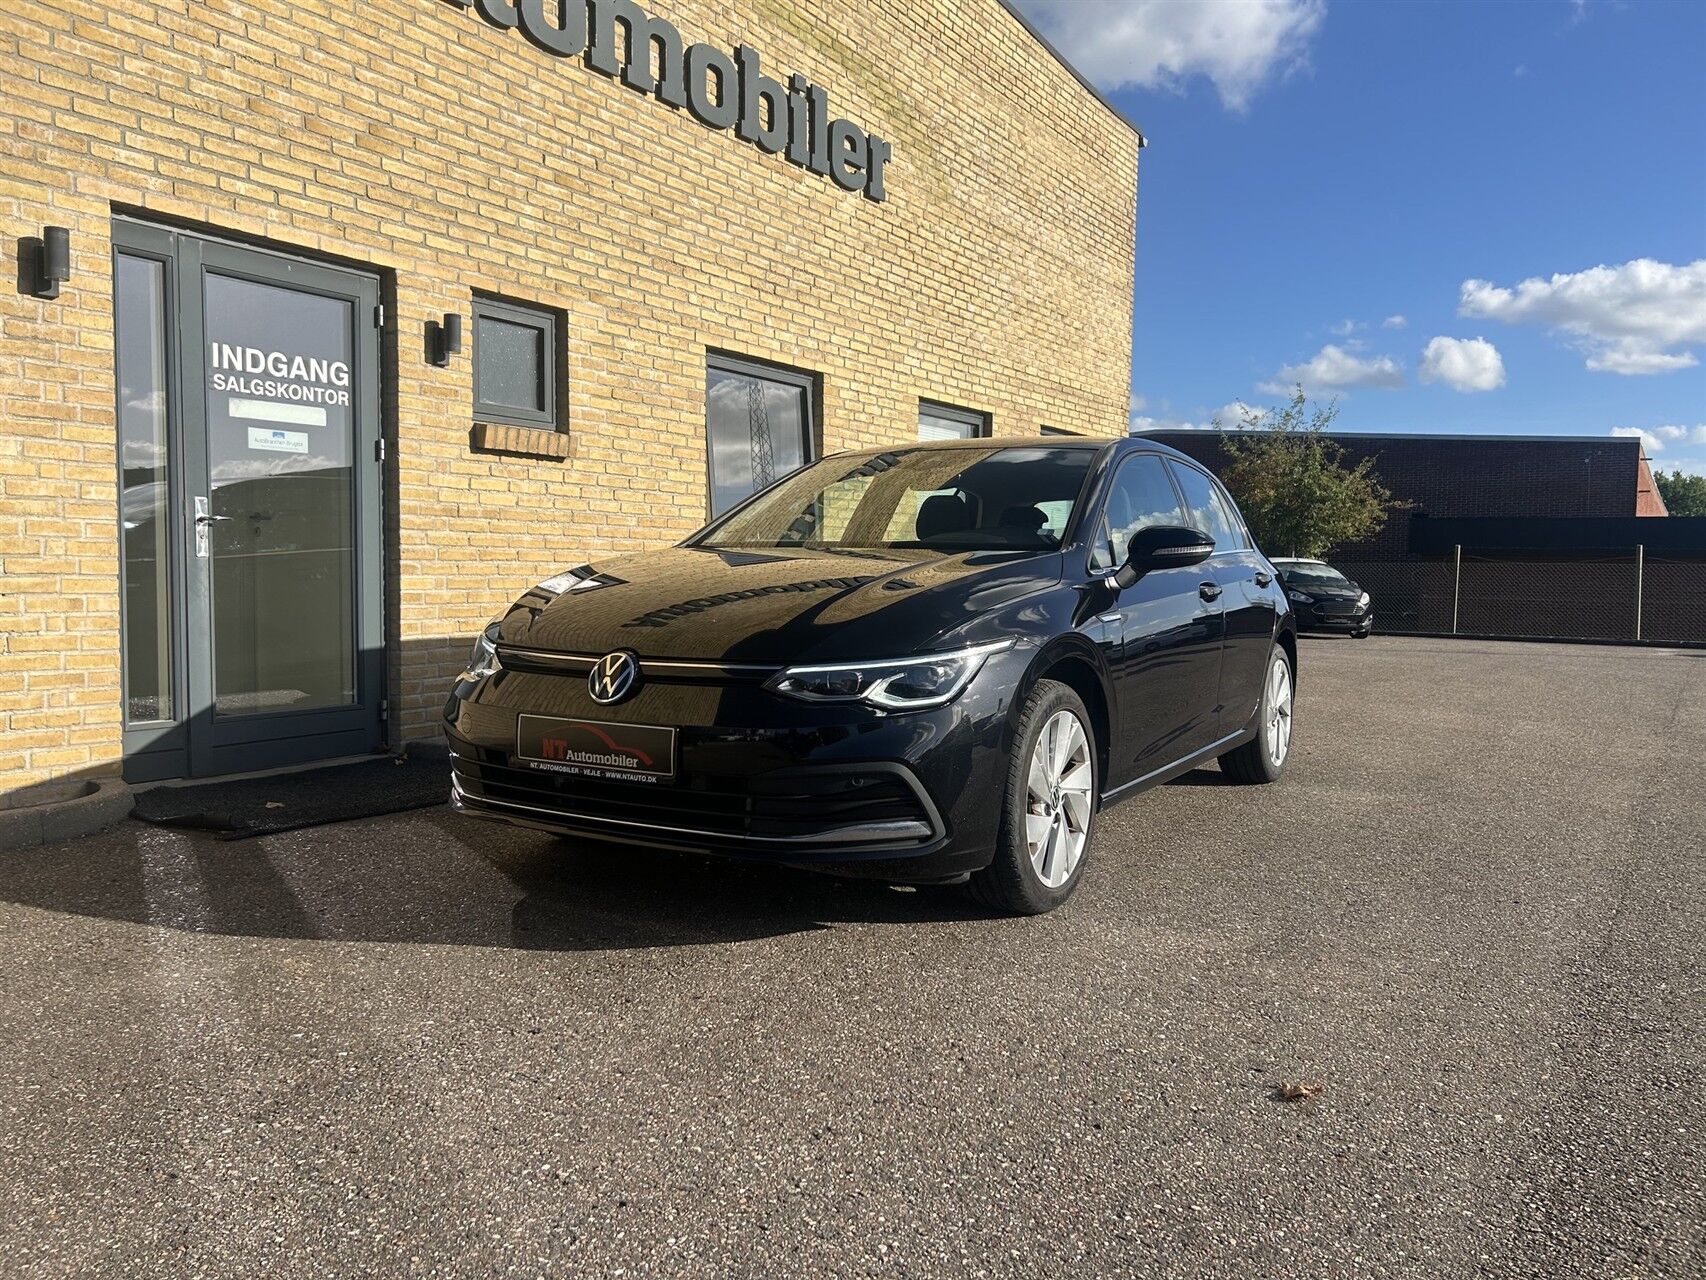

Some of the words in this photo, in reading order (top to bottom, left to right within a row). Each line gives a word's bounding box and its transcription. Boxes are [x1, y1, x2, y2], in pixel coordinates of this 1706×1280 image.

[212, 342, 349, 387] INDGANG
[213, 373, 349, 407] SALGSKONTOR
[542, 738, 567, 759] NT
[566, 749, 639, 768] Automobiler
[540, 763, 579, 774] AUTOMOBILER
[583, 769, 601, 777] VEJLE
[605, 771, 657, 783] WWW.NTAUTO.DK
